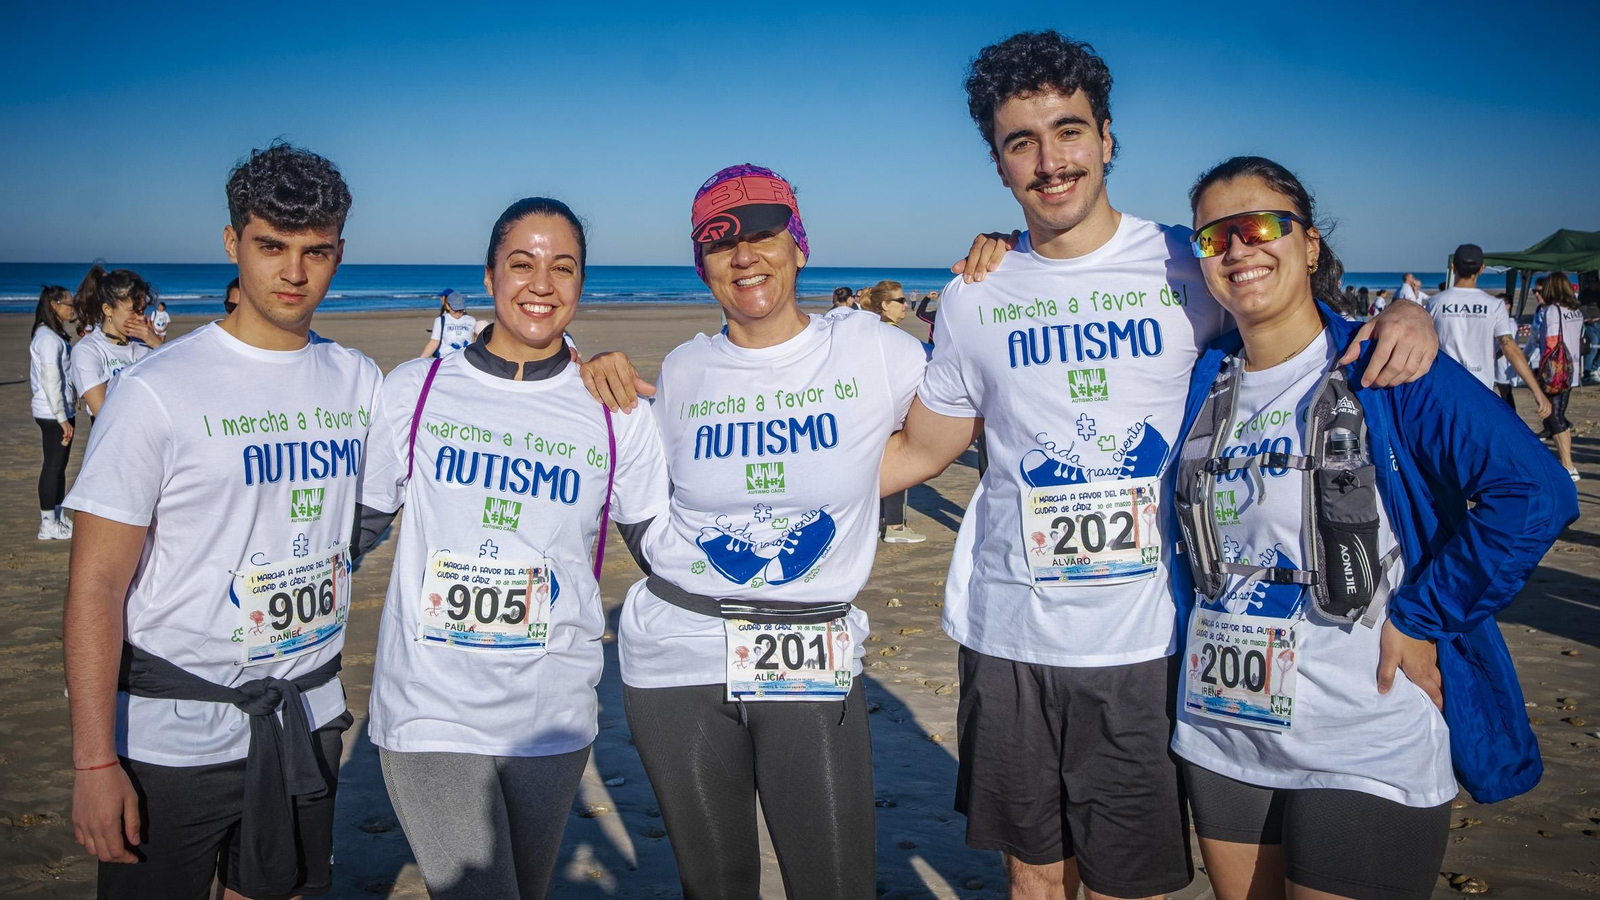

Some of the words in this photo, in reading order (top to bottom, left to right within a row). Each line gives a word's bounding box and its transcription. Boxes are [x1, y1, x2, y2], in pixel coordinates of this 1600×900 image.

[978, 305, 984, 326] I
[993, 298, 1058, 324] marcha
[1068, 297, 1079, 314] a
[1090, 290, 1147, 312] favor
[1159, 283, 1188, 307] del
[1442, 304, 1488, 314] KIABI
[1007, 317, 1164, 369] AUTISMO
[679, 401, 685, 420] I
[688, 394, 746, 419] marcha
[756, 394, 765, 412] a
[775, 387, 824, 410] favor
[834, 376, 859, 401] del
[203, 415, 212, 437] I
[222, 410, 289, 436] marcha
[296, 411, 307, 430] a
[314, 407, 353, 430] favor
[694, 412, 840, 460] AUTISMO
[426, 422, 492, 444] marcha
[503, 433, 512, 447] a
[524, 432, 577, 460] favor
[586, 445, 609, 470] del
[1035, 431, 1085, 468] Cada
[1112, 417, 1148, 462] cuenta
[243, 438, 362, 486] AUTISMO
[435, 445, 582, 506] AUTISMO
[1216, 436, 1294, 484] ISMO
[1034, 505, 1058, 515] CIUDAD
[1060, 504, 1070, 513] de
[1038, 494, 1067, 503] MARCHA
[1078, 490, 1102, 500] FAVOR
[1104, 489, 1118, 497] DEL
[1050, 510, 1136, 555] 202
[256, 570, 286, 583] MARCHA
[288, 568, 294, 576] A
[296, 563, 315, 574] FAVOR
[316, 560, 324, 569] DEL
[436, 570, 460, 580] CIUDAD
[461, 574, 470, 582] de
[443, 561, 470, 571] MARCHA
[480, 566, 502, 576] FAVOR
[504, 568, 516, 576] DEL
[1338, 544, 1356, 594] AONIJIE
[252, 583, 276, 594] CIUDAD
[279, 581, 288, 589] de
[269, 578, 334, 630] 906
[447, 584, 527, 624] 905
[270, 629, 302, 644] DANIEL
[444, 622, 475, 633] PAULA
[738, 624, 762, 632] CIUDAD
[1242, 626, 1254, 634] DEL
[1256, 626, 1286, 637] AUTISMO
[1250, 640, 1266, 648] marzo
[754, 634, 826, 670] 201
[1200, 642, 1266, 692] 200
[754, 674, 786, 682] ALICIA
[1202, 686, 1222, 698] IRENE
